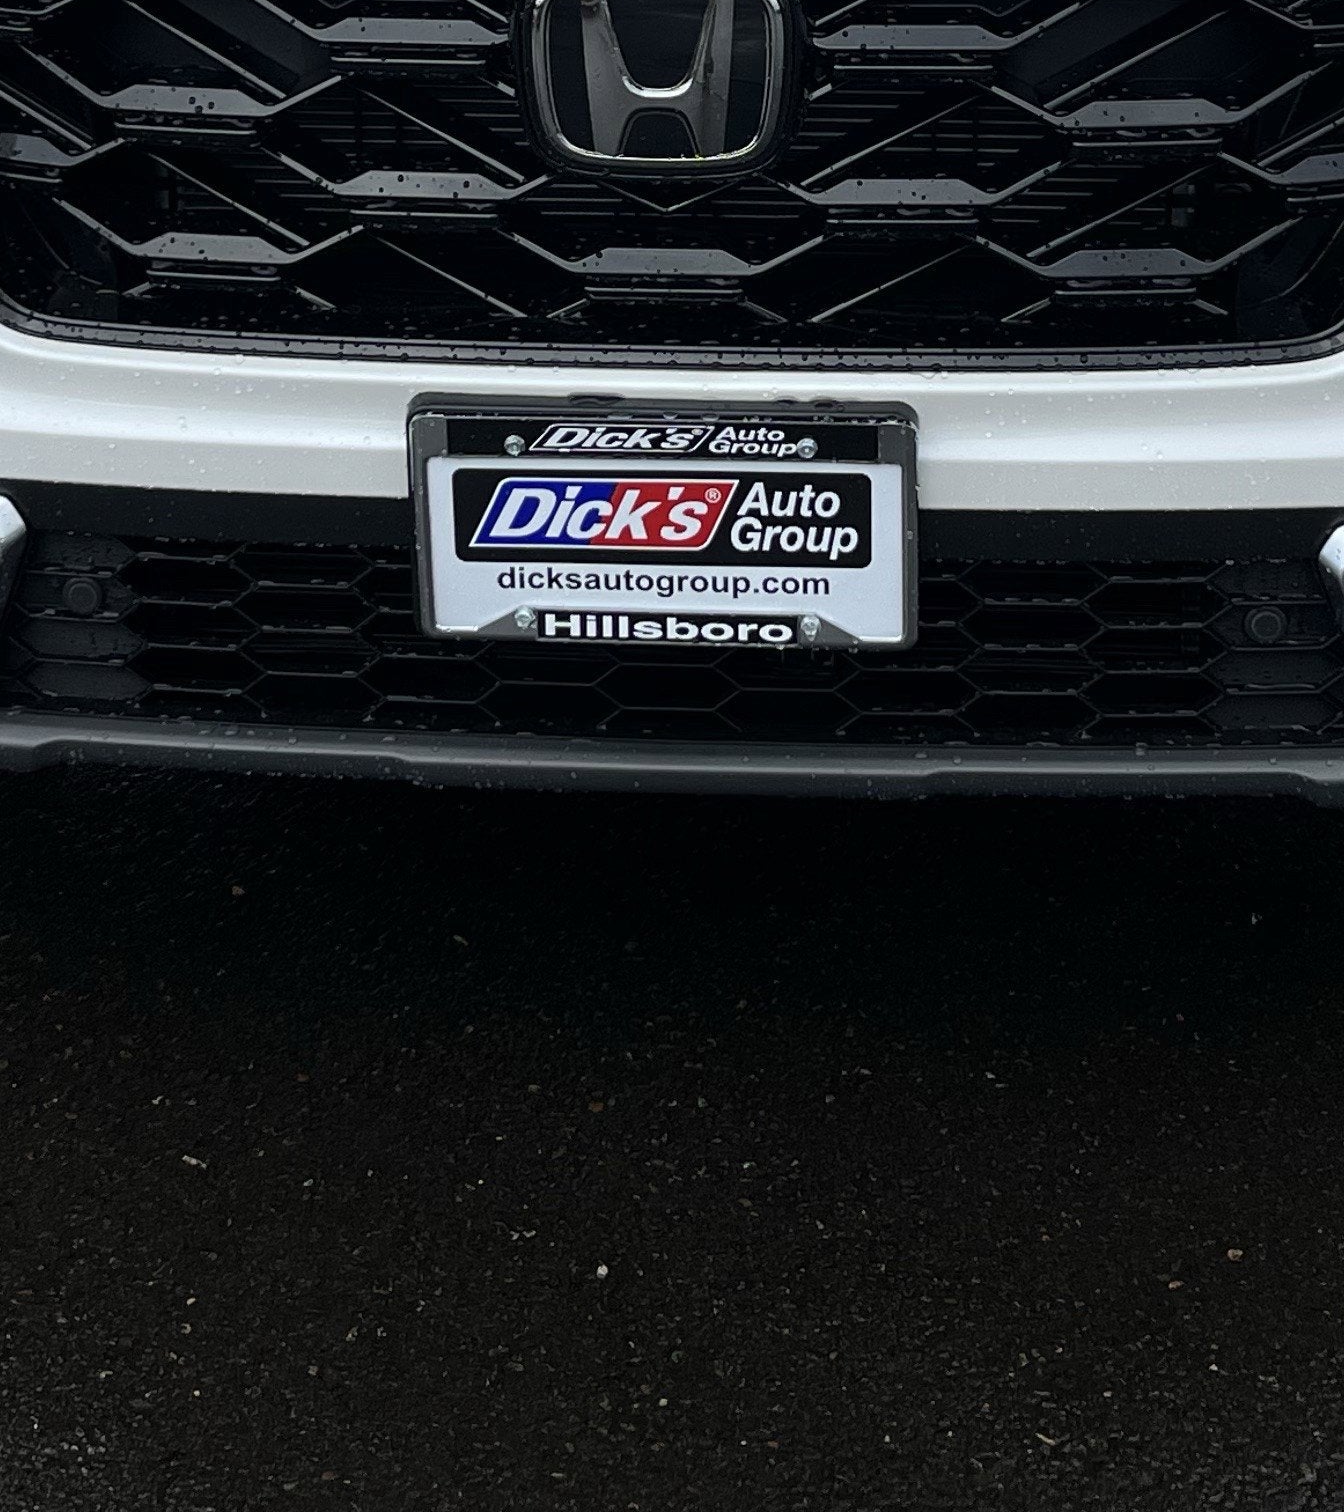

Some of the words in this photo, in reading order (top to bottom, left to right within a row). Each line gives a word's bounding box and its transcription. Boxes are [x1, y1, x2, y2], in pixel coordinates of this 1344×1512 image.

[708, 439, 797, 457] Group
[714, 426, 785, 441] Auto
[737, 481, 841, 518] Auto
[729, 518, 859, 560] Group
[497, 566, 830, 598] dicksautogroup.com
[544, 613, 793, 643] Hillsboro
